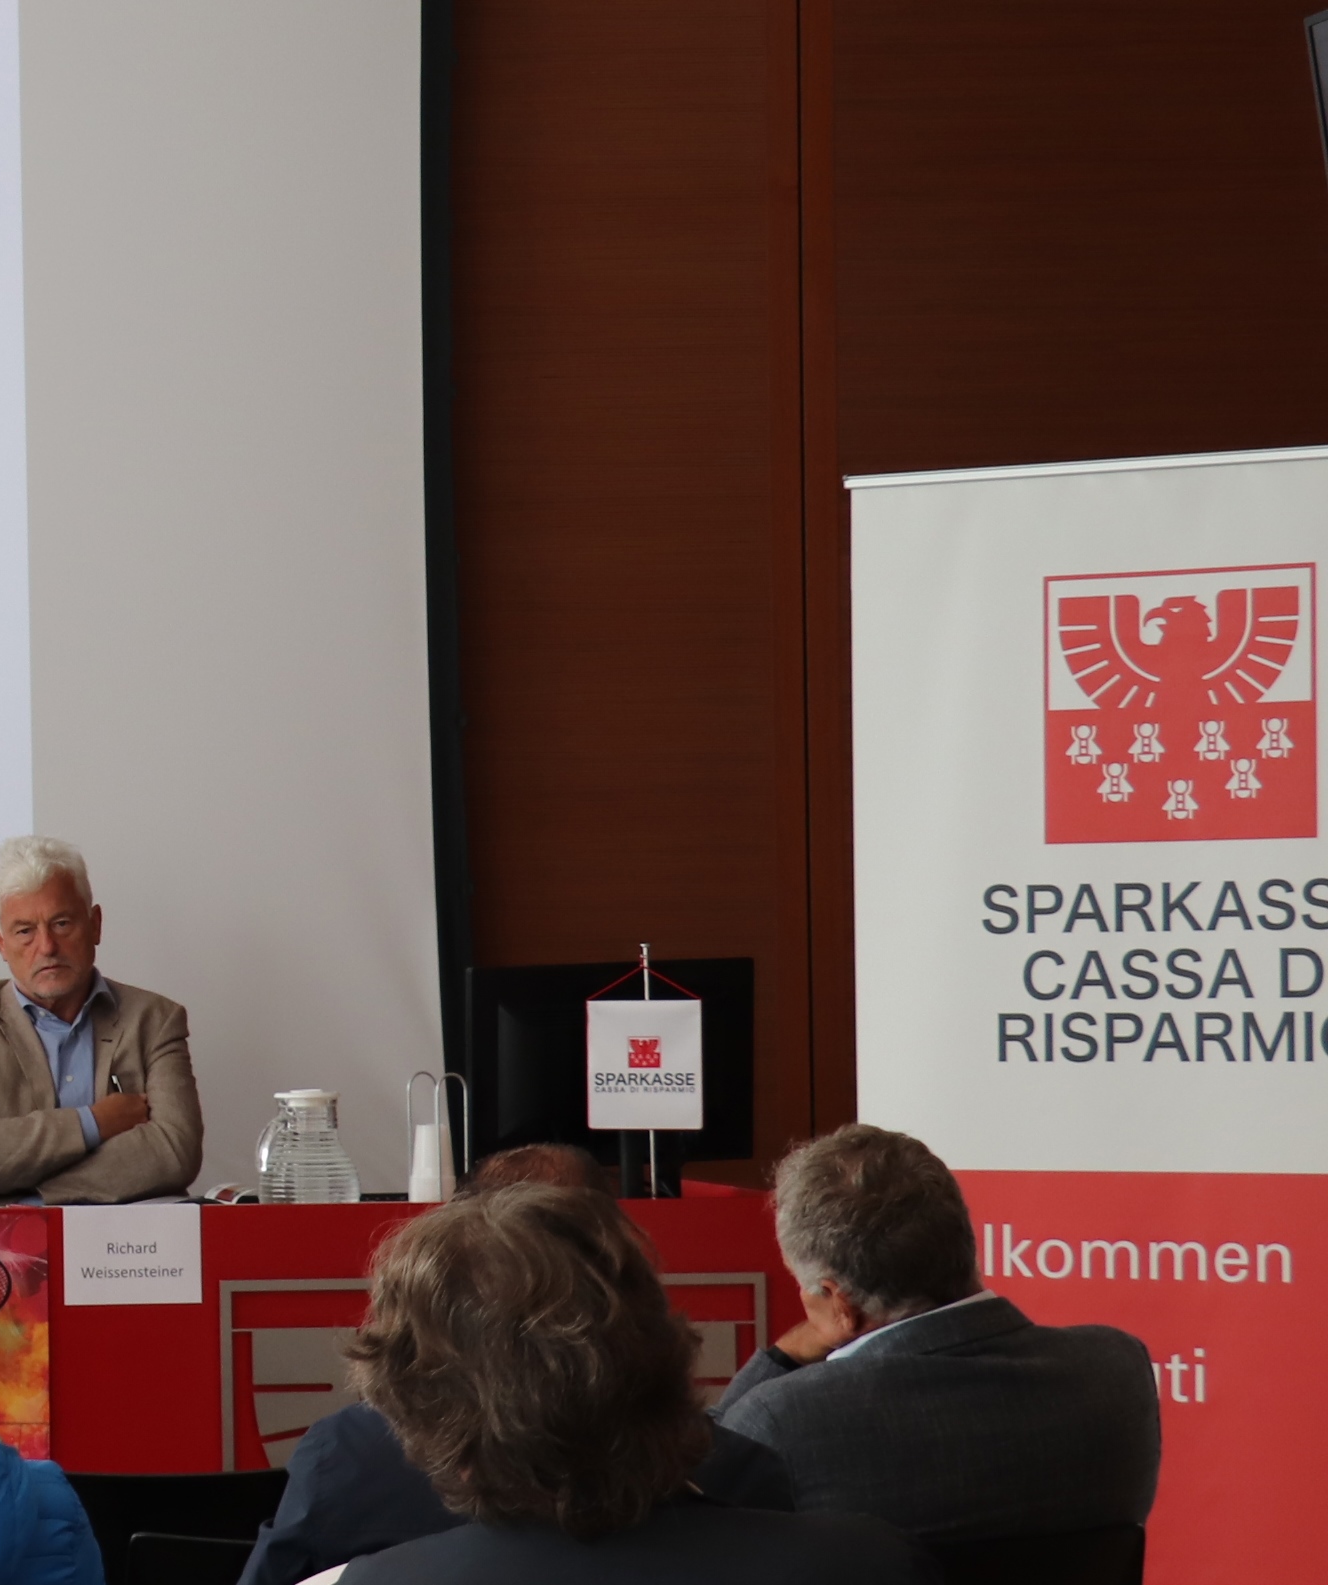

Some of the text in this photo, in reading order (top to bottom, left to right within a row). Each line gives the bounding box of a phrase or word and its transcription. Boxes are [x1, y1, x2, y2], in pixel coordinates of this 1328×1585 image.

[982, 878, 1328, 934] SPARKASS
[1022, 947, 1324, 1001] CASSA D
[998, 1011, 1328, 1063] RISPARMI
[594, 1073, 695, 1086] SPARKASSE
[81, 1265, 184, 1279] Weissensteiner
[107, 1242, 157, 1254] Richard
[983, 1223, 1292, 1283] lkommen
